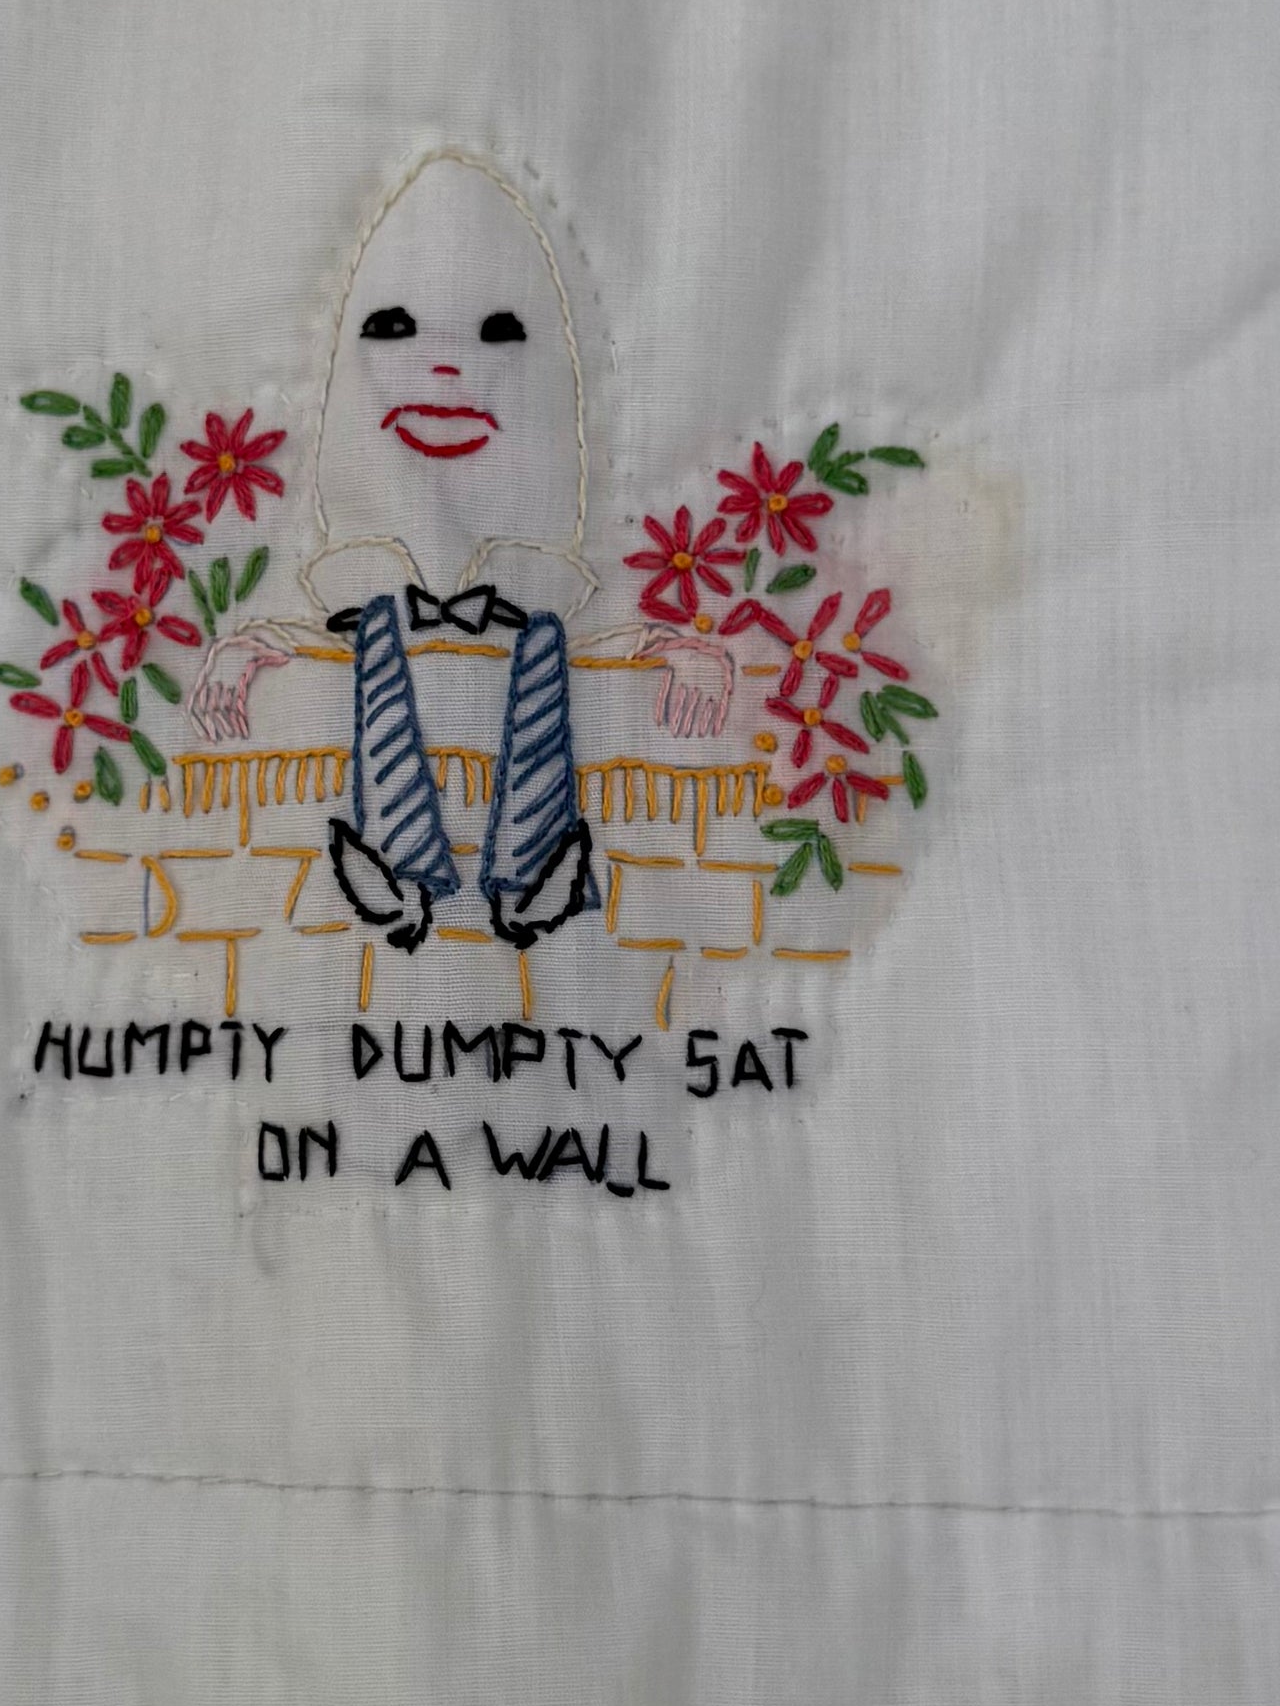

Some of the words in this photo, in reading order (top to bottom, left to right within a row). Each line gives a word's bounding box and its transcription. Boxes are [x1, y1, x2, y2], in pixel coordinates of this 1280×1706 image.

[34, 1020, 287, 1084] HUMPTY
[351, 1018, 643, 1091] DUMPTY
[685, 1027, 810, 1099] SAT
[257, 1119, 339, 1182] ON
[394, 1129, 452, 1191] A
[481, 1120, 671, 1198] WALL
